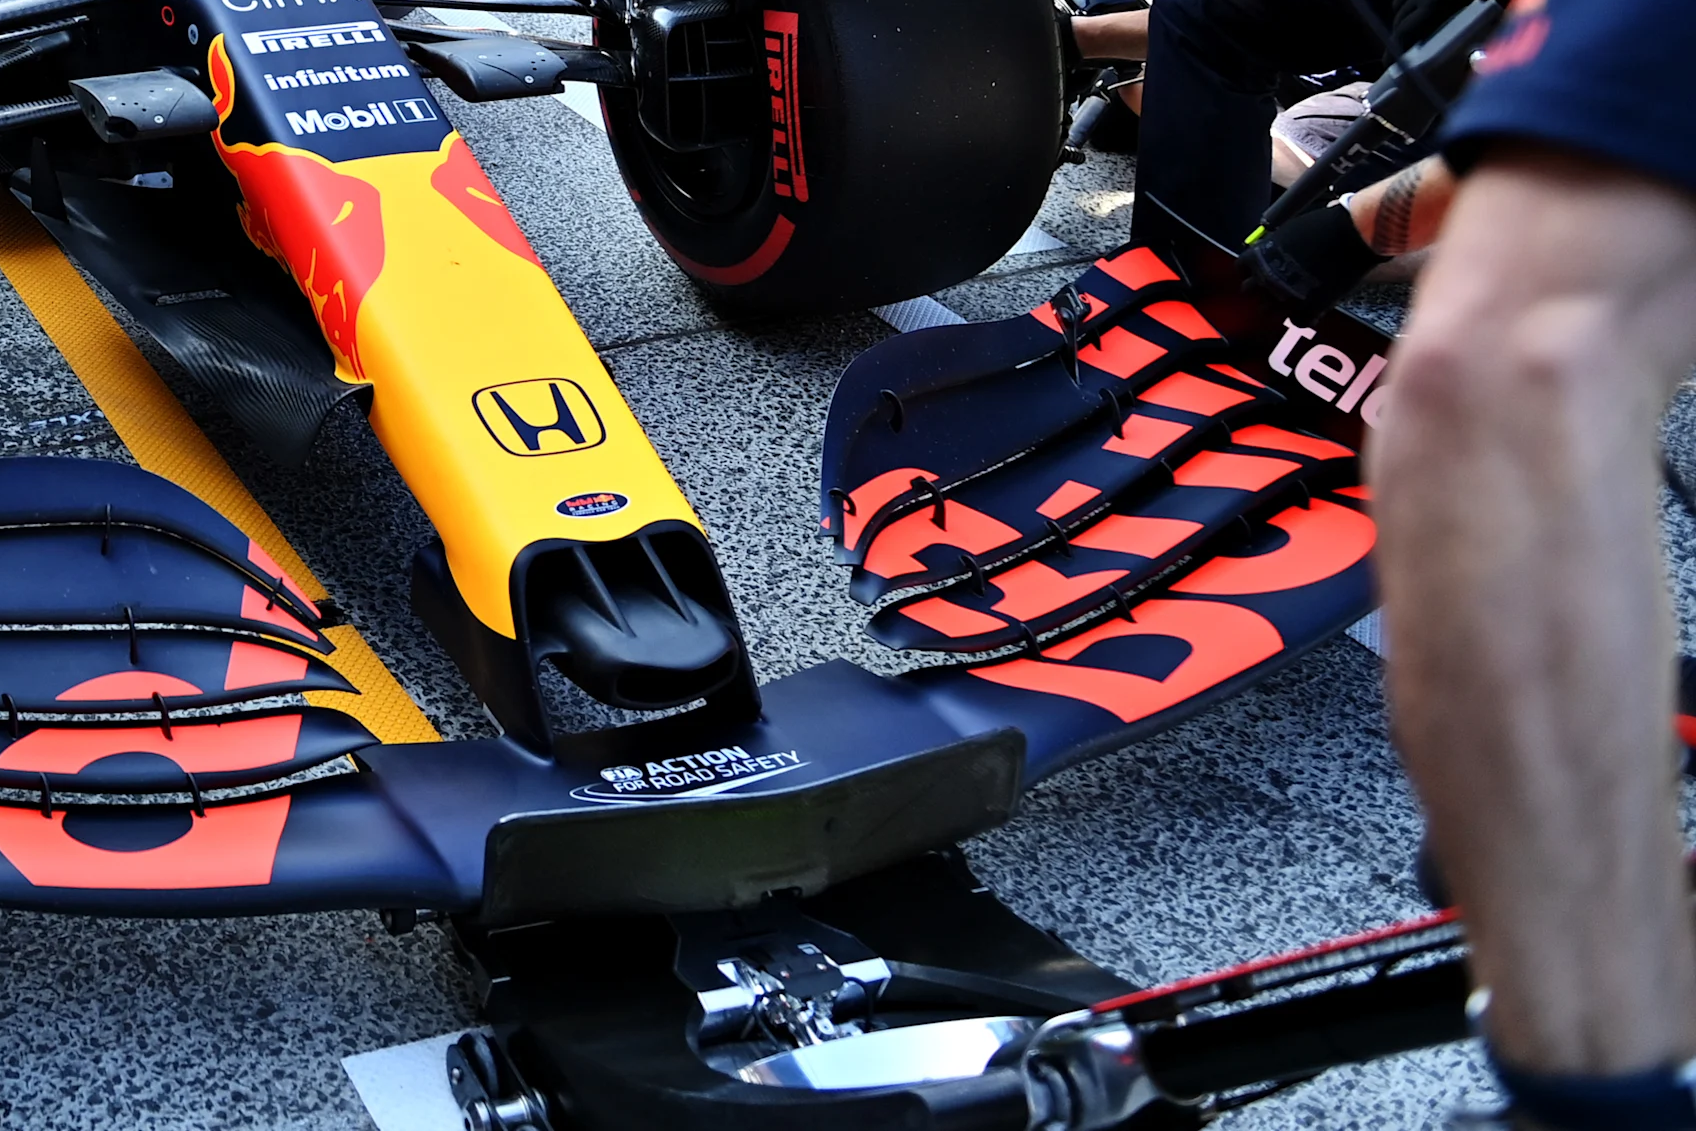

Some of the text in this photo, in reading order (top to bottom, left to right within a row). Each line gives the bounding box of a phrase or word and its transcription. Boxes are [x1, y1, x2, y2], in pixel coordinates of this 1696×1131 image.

[241, 20, 387, 54] PIRELLI
[264, 62, 410, 91] infinitum
[284, 101, 397, 136] Mobil
[763, 8, 810, 203] PIRELLI
[603, 745, 751, 782] FIA ACTION
[613, 749, 801, 794] FOR ROAD SAFETY
